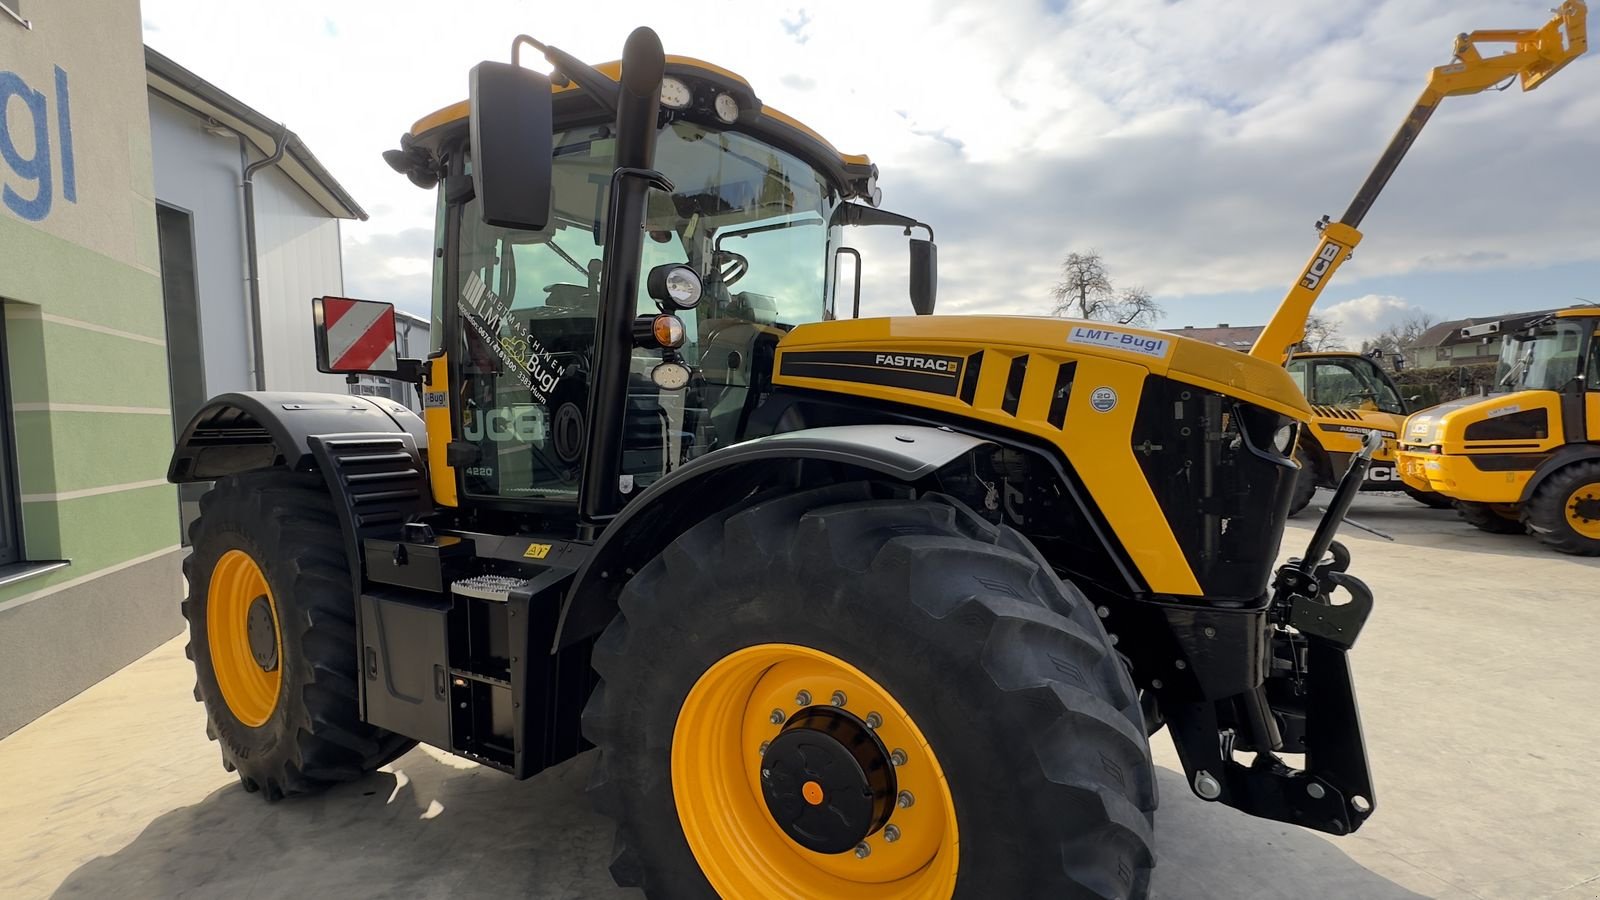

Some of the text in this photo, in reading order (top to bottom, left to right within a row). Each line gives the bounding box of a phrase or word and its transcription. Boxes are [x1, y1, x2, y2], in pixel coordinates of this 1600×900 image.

[1305, 243, 1341, 289] JCB
[486, 289, 566, 377] MIETMASCHINEN
[1075, 328, 1163, 351] LMT-Bugl
[478, 326, 492, 344] 0676
[517, 371, 532, 388] 3383
[530, 384, 547, 405] Hurm
[526, 353, 560, 393] Bugl
[875, 354, 947, 371] FASTRAC
[464, 408, 546, 441] JCB
[466, 466, 493, 477] 4220
